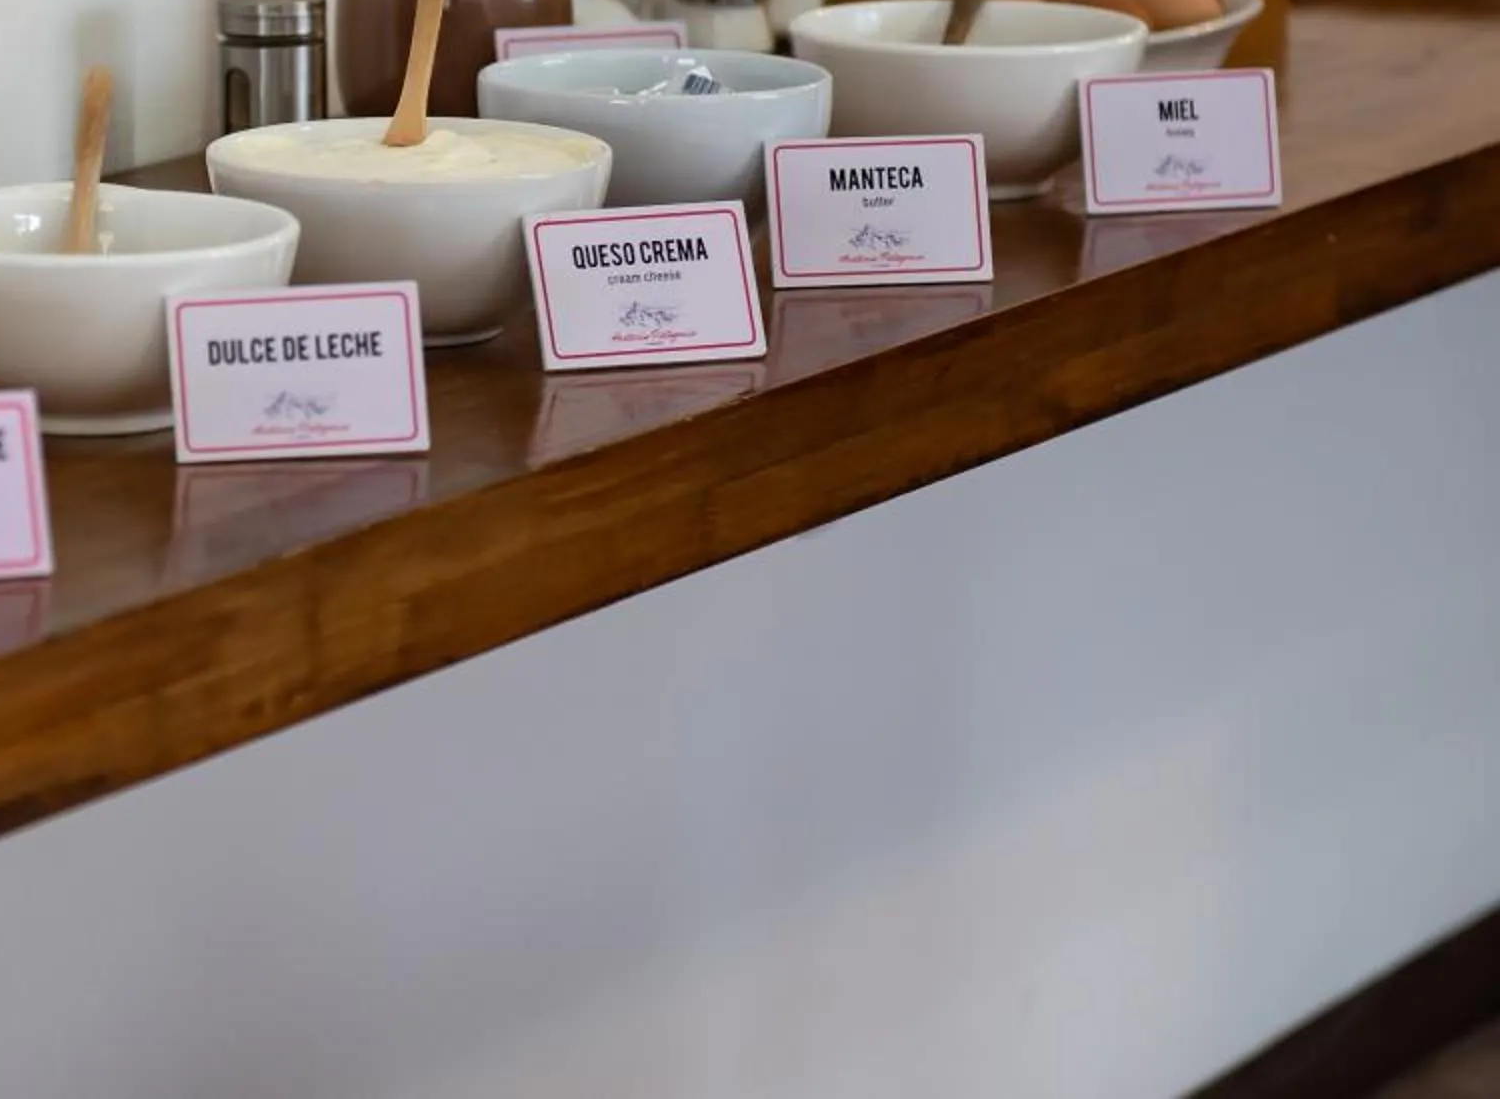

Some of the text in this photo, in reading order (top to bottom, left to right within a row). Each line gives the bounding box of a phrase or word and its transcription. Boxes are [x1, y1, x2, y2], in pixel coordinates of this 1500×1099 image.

[1158, 98, 1199, 121] MIEL
[829, 166, 924, 191] MANTECA
[572, 237, 709, 269] QUESO CREMA
[607, 269, 682, 285] cream cheese
[208, 331, 383, 366] DULCE DE LECHE
